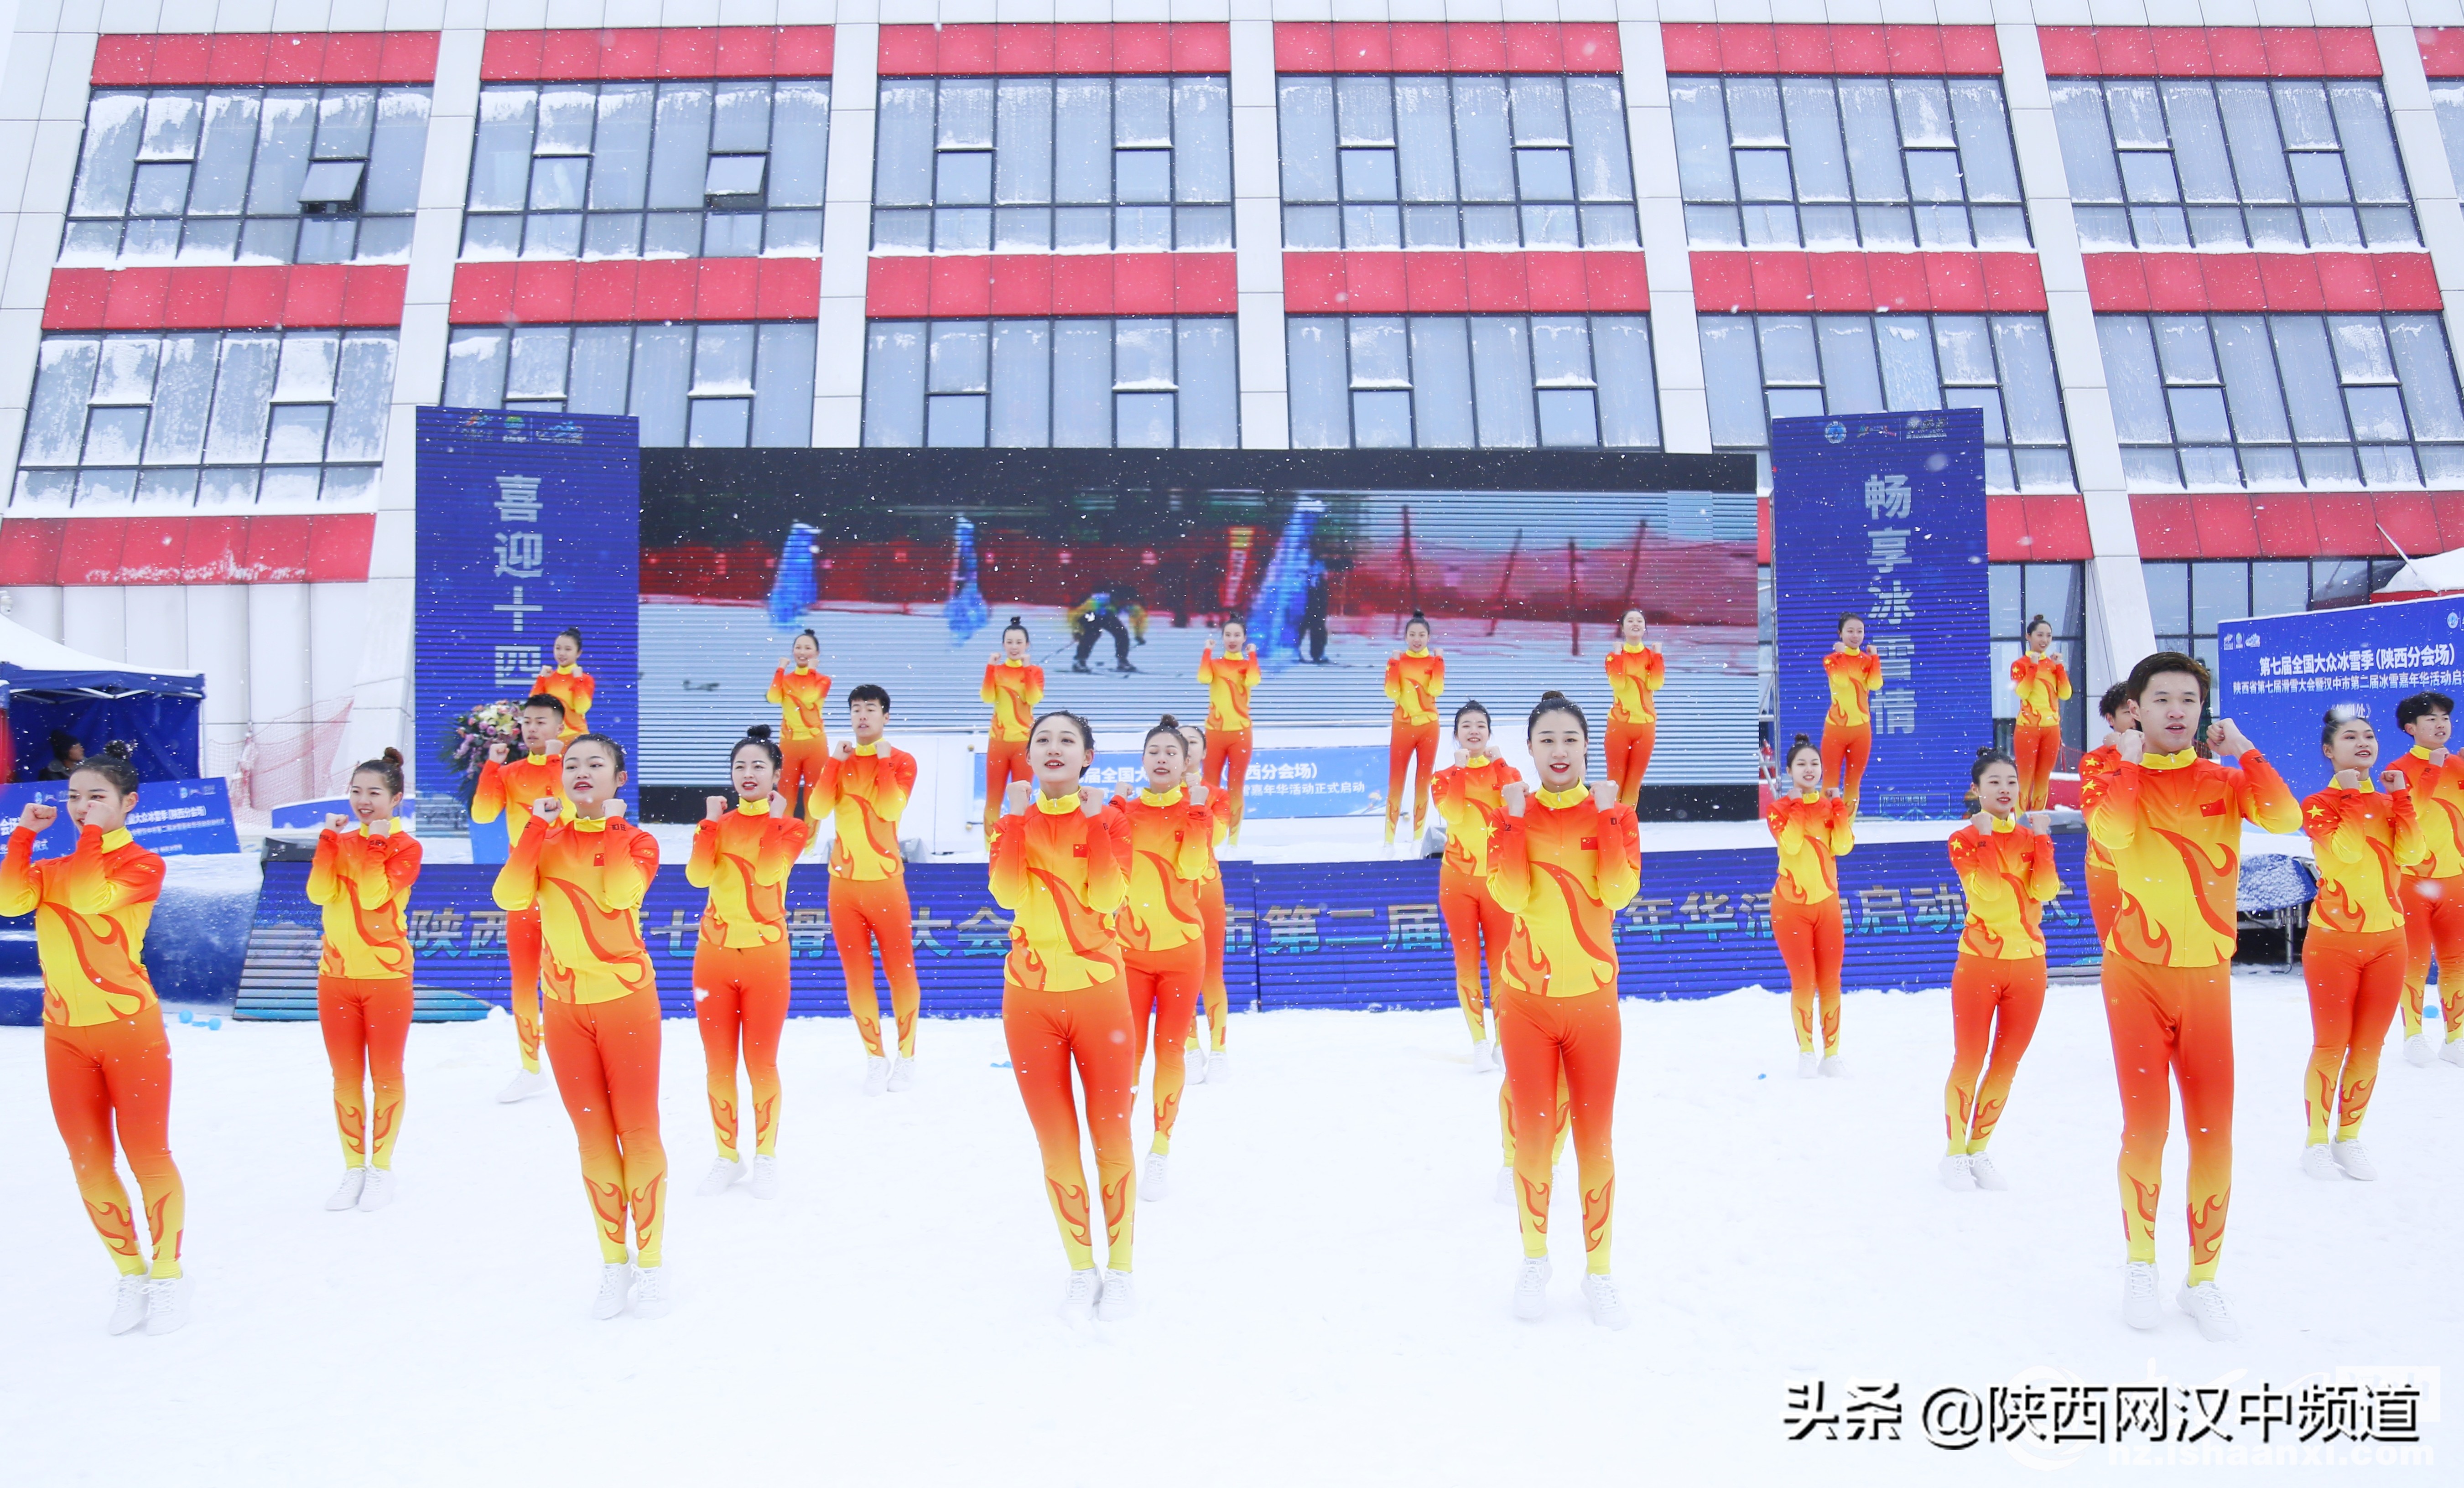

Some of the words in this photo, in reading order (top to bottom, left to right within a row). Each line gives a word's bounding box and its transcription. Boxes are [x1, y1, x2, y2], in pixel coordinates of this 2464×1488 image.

[1864, 474, 1917, 735] 畅享冰雪情
[2233, 669, 2464, 695] 陕西省第七届滑雪大会暨汉中市第二届冰雪嘉年华活动启
